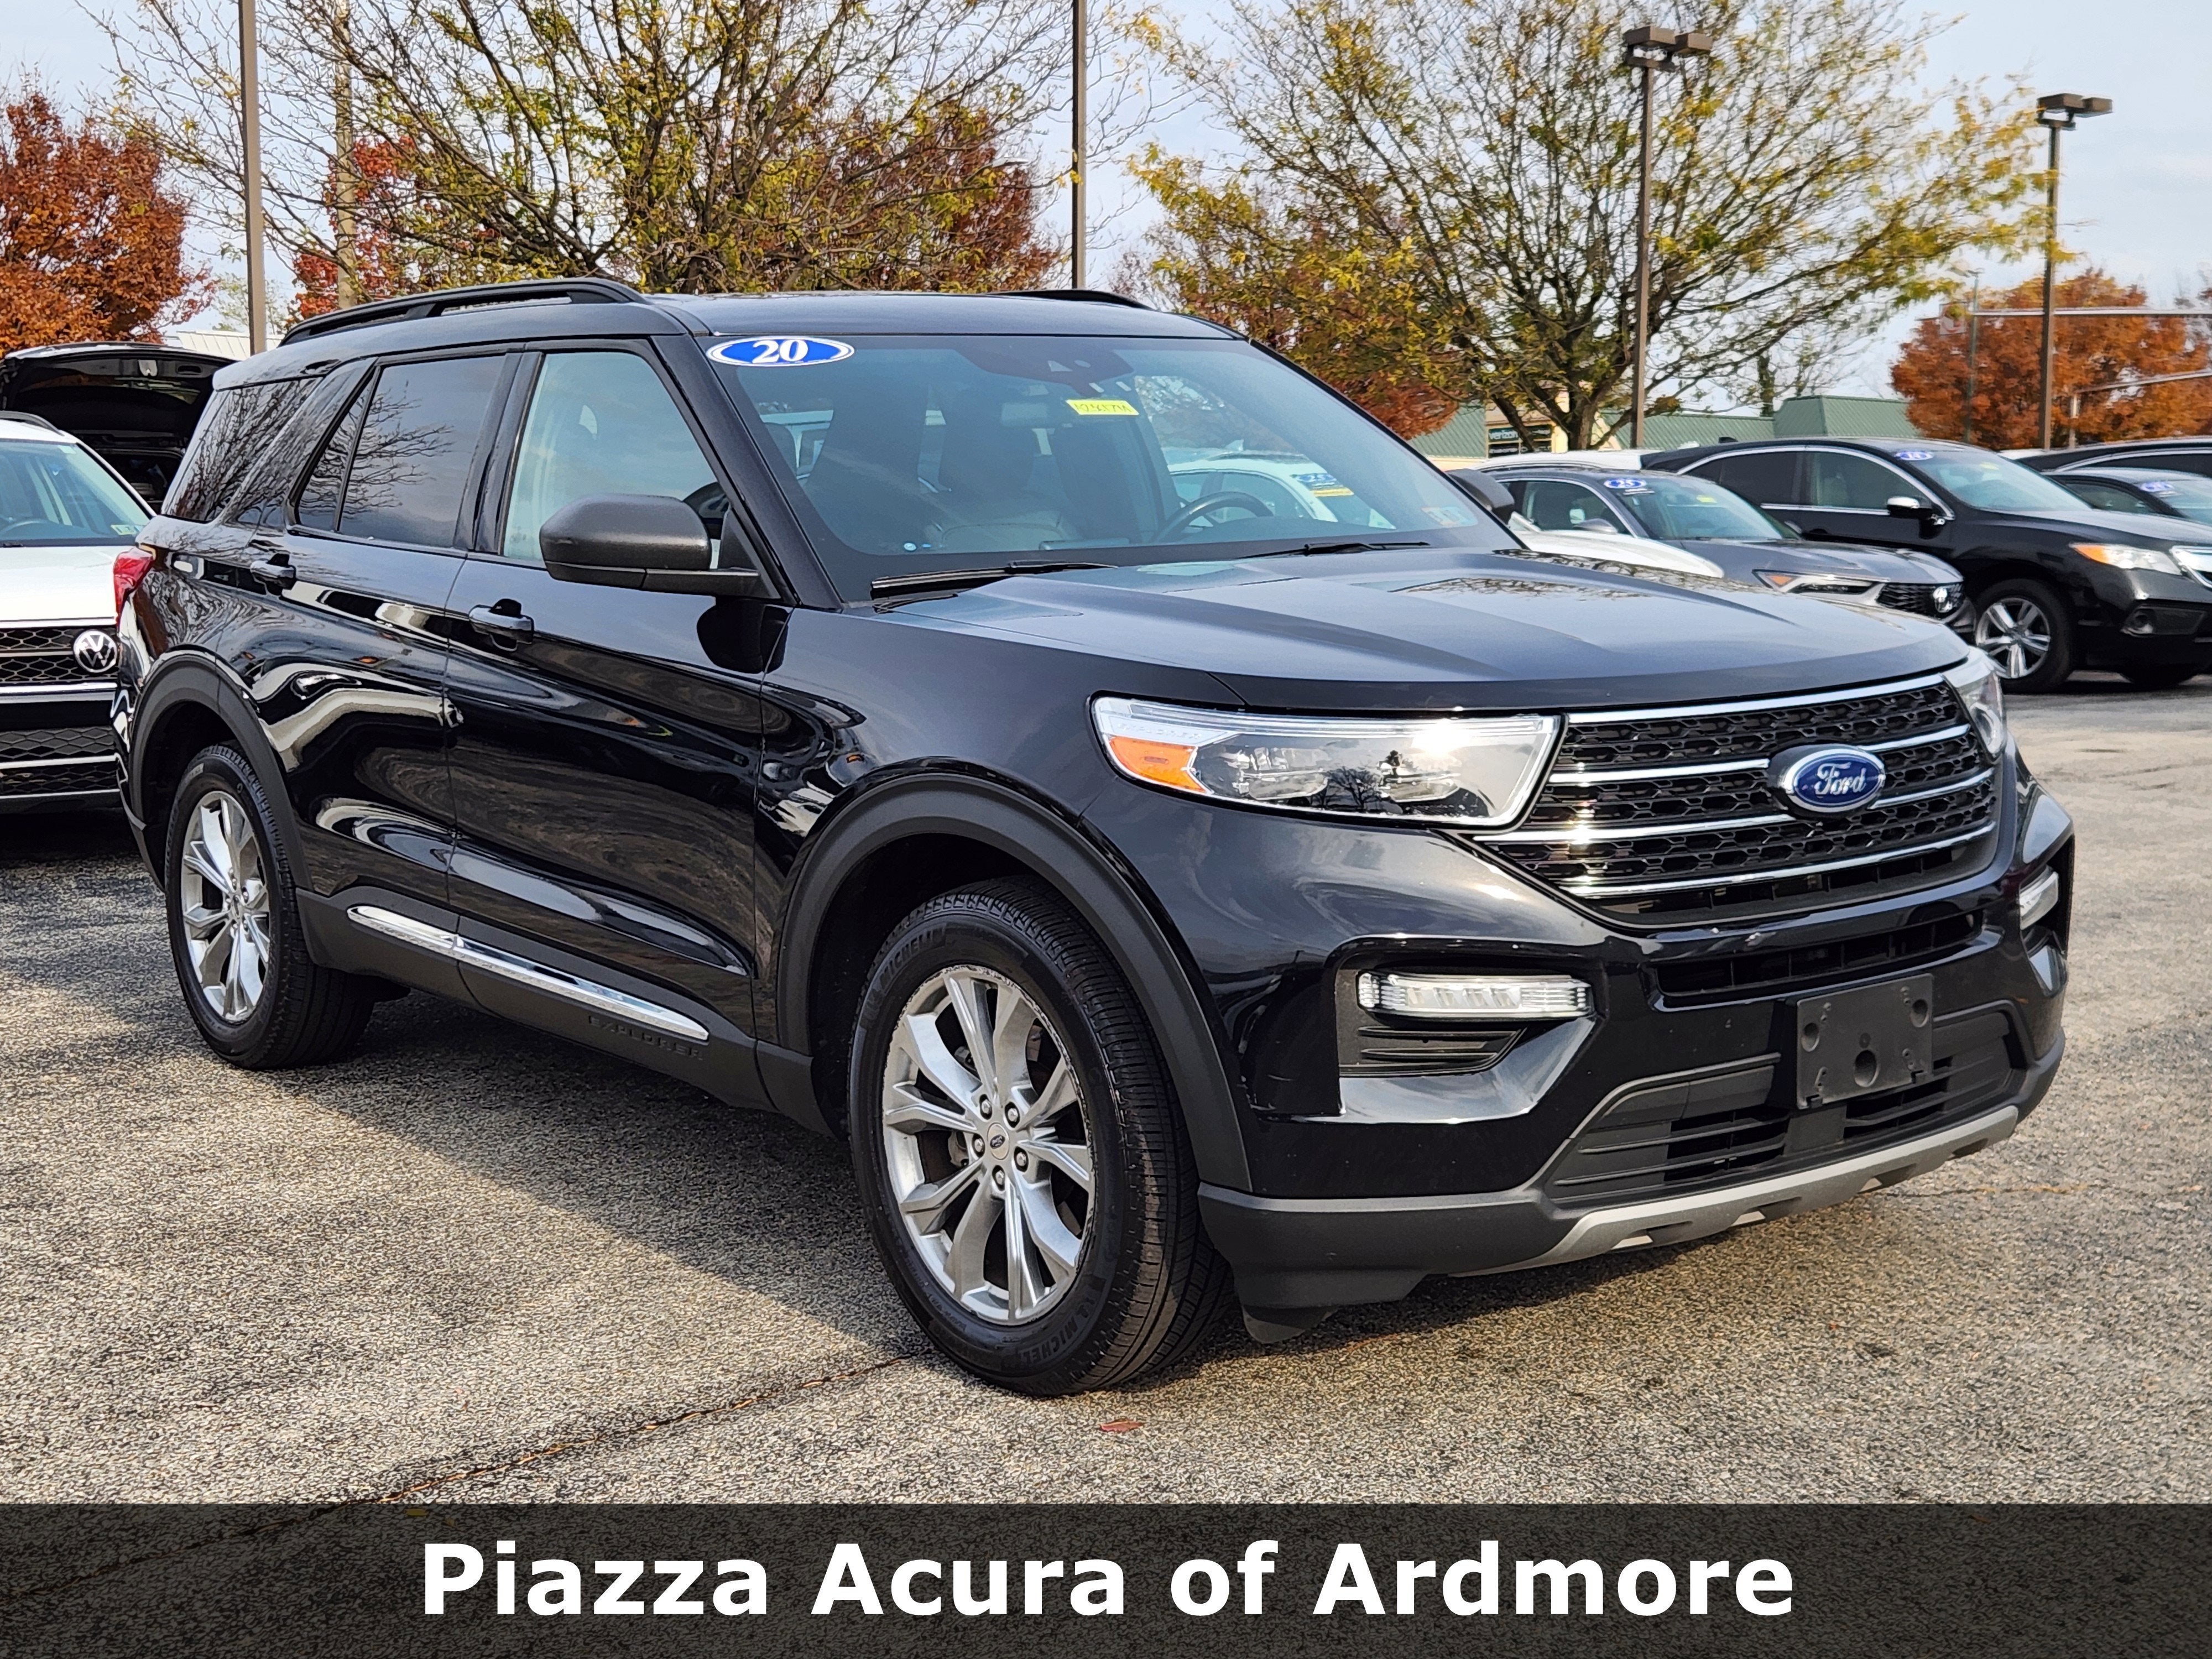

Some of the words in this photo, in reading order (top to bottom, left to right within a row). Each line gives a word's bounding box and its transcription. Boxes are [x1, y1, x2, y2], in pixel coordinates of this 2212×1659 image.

[752, 340, 808, 364] 20
[1489, 430, 1519, 440] verizon
[1616, 479, 1636, 488] 25
[1814, 762, 1867, 795] Ford
